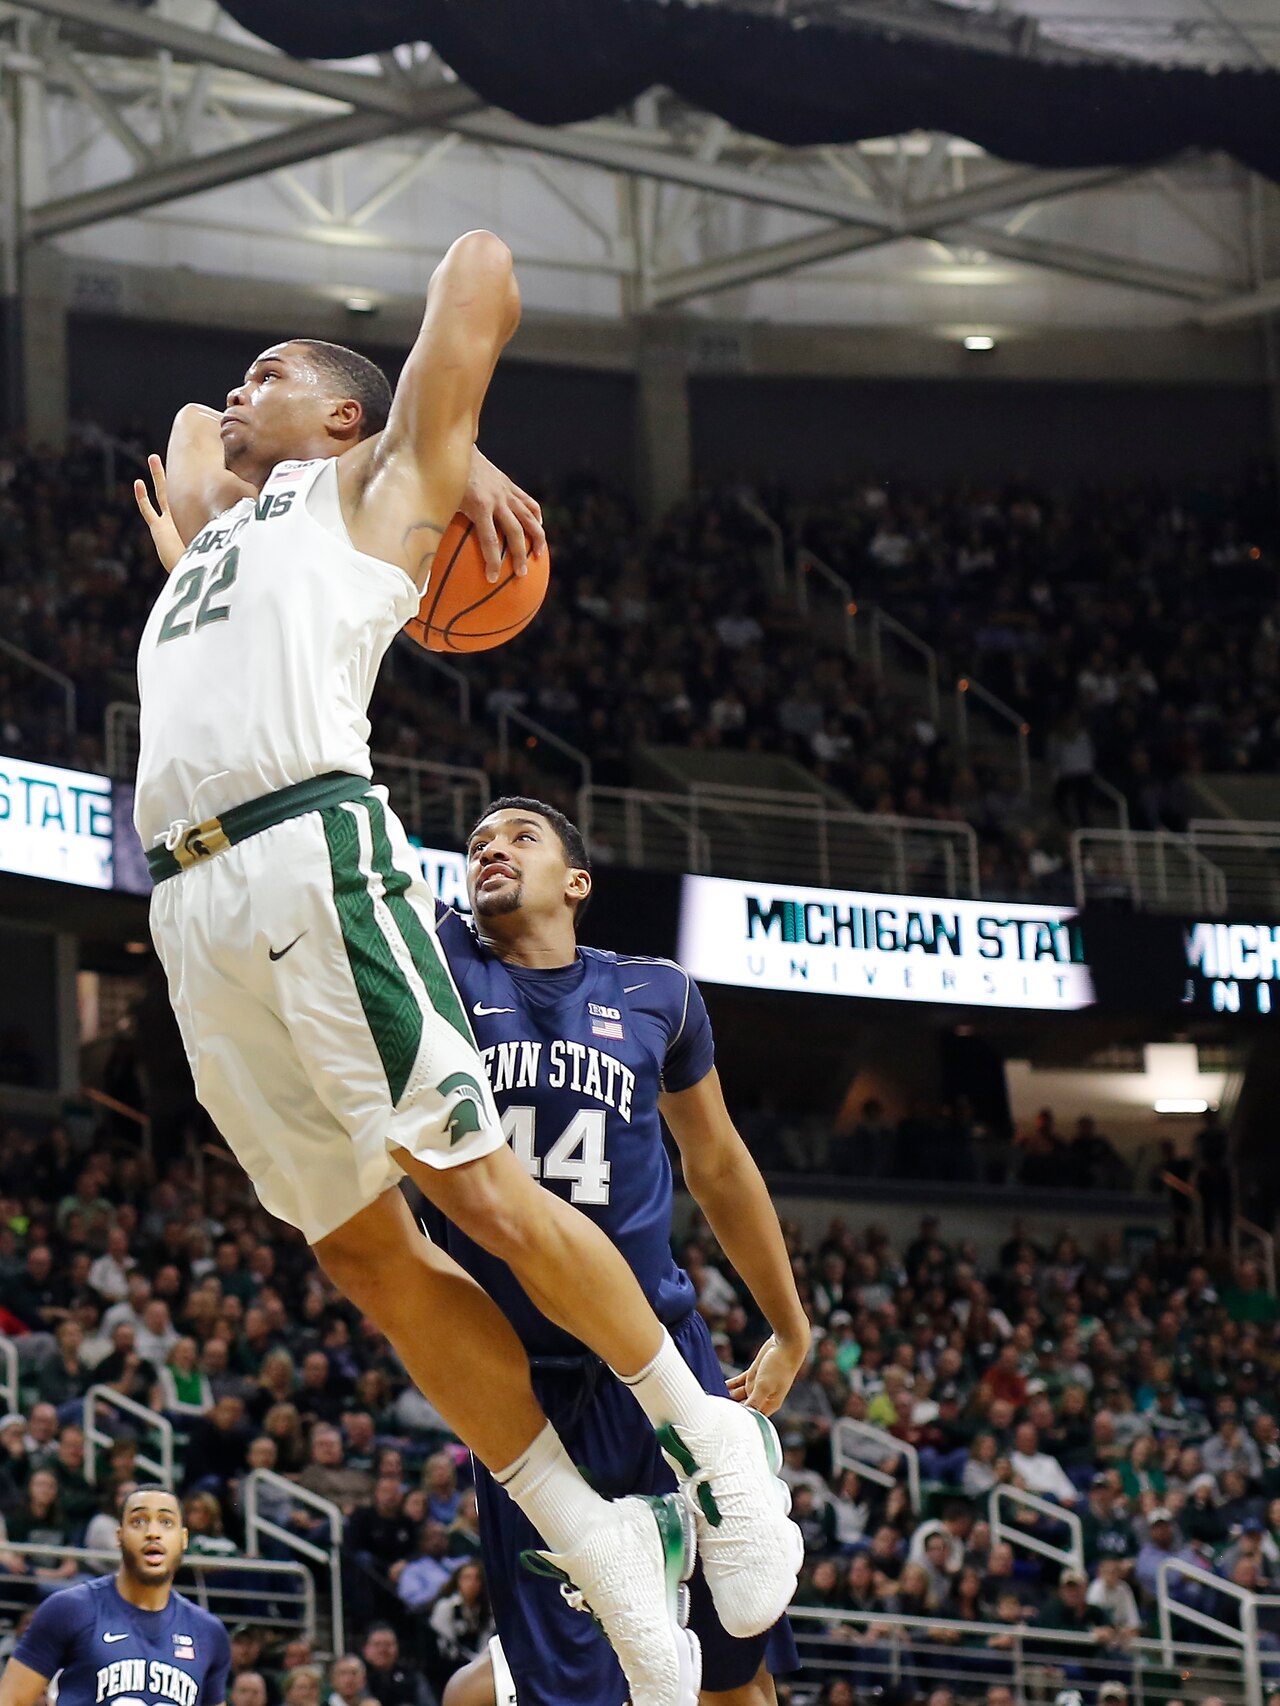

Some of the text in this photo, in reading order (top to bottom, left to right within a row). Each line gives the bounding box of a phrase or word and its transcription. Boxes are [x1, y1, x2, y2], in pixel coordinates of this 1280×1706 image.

[156, 544, 241, 648] 22
[746, 896, 960, 957] MICHIGAN
[480, 1040, 635, 1124] ENN STATE
[500, 1105, 611, 1205] 44
[96, 1658, 198, 1706] PENN STATE
